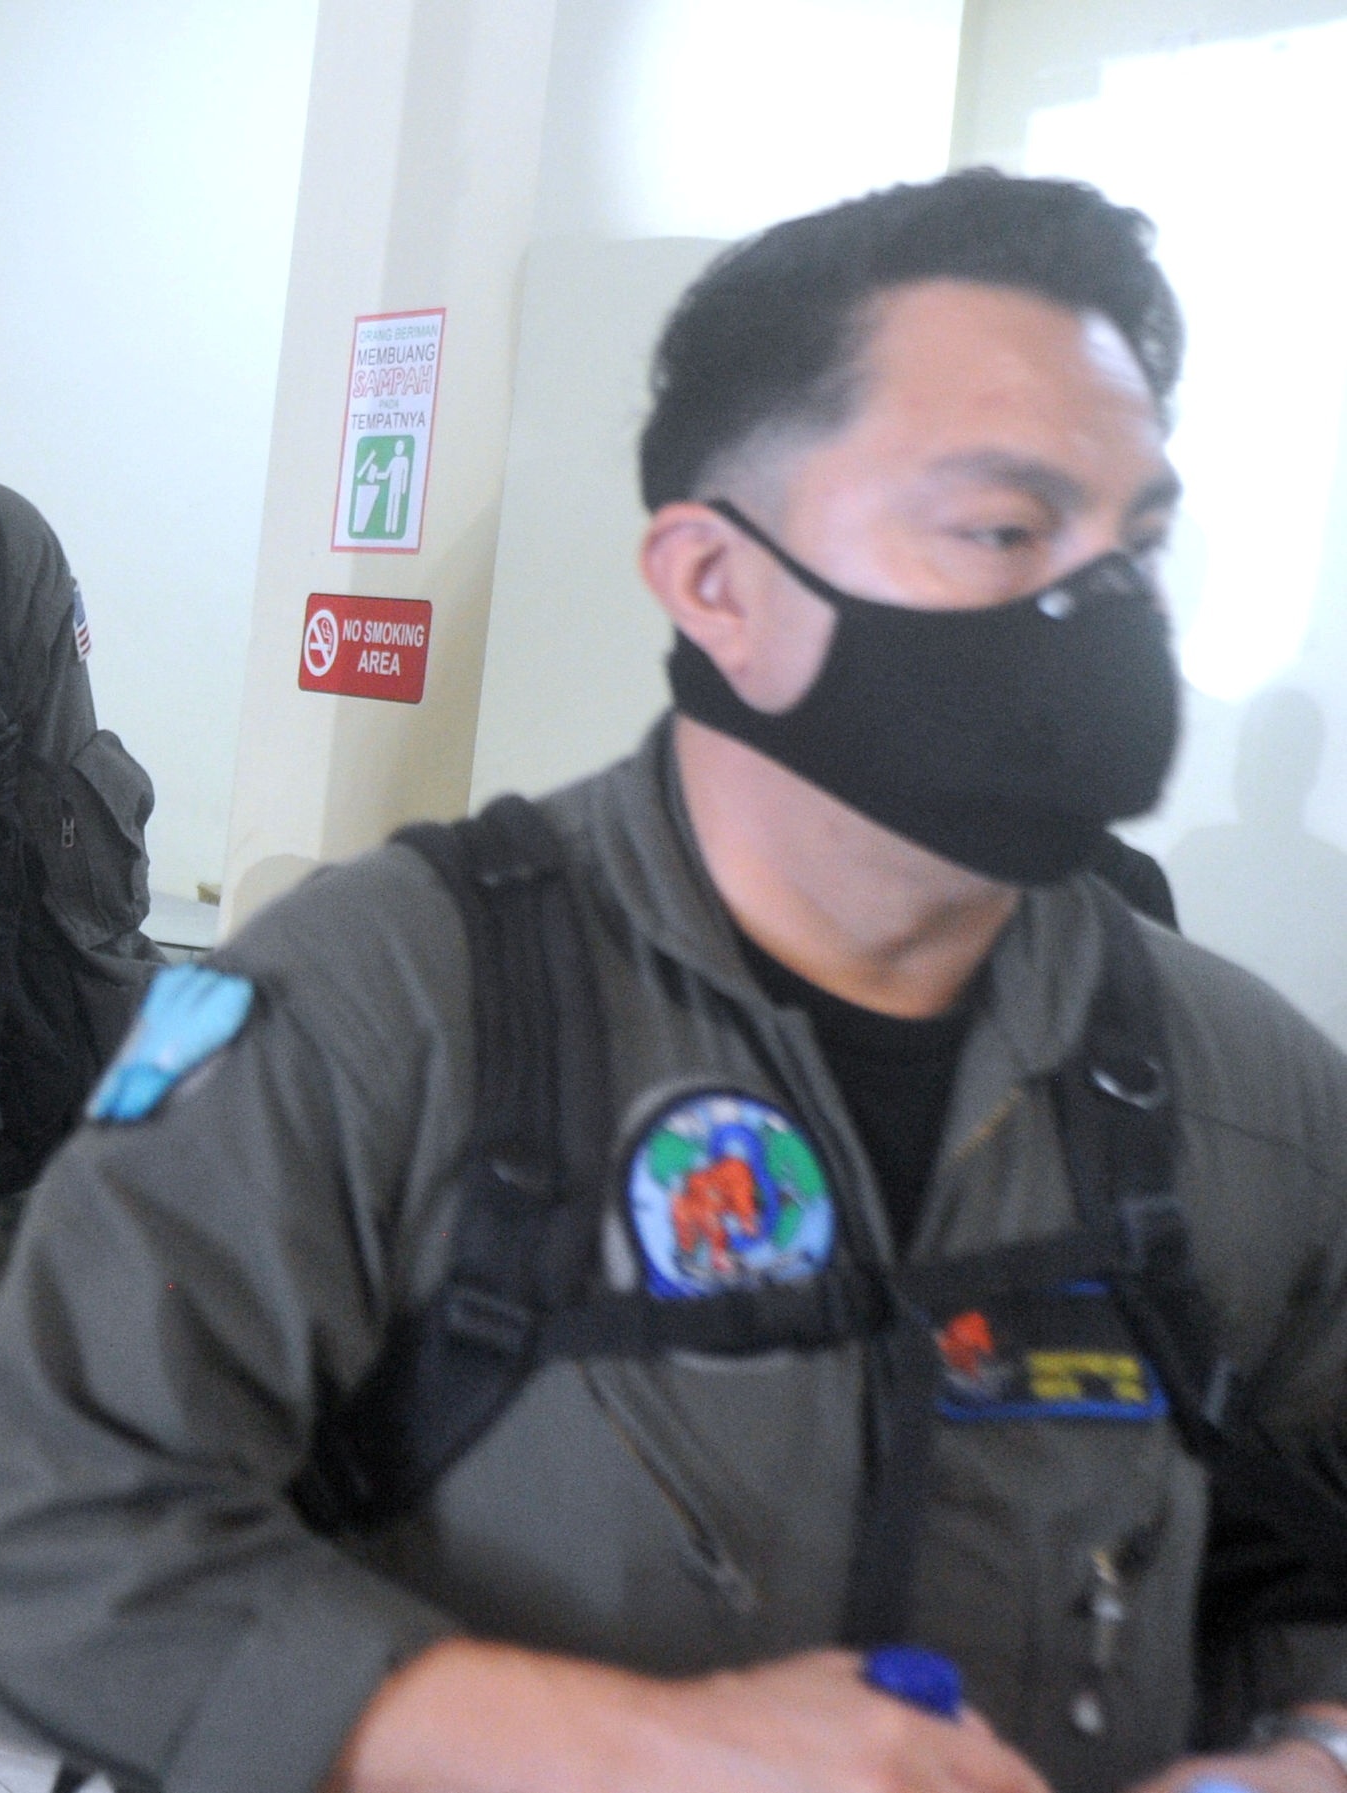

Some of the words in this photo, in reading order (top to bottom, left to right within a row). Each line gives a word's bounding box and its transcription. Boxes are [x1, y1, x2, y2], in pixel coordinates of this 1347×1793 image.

[356, 343, 436, 367] MEMBUANG
[352, 365, 433, 398] SAMPAH
[351, 411, 426, 430] TEMPATNYA
[342, 619, 362, 642] NO
[363, 620, 425, 647] SMOKING
[357, 650, 401, 676] AREA
